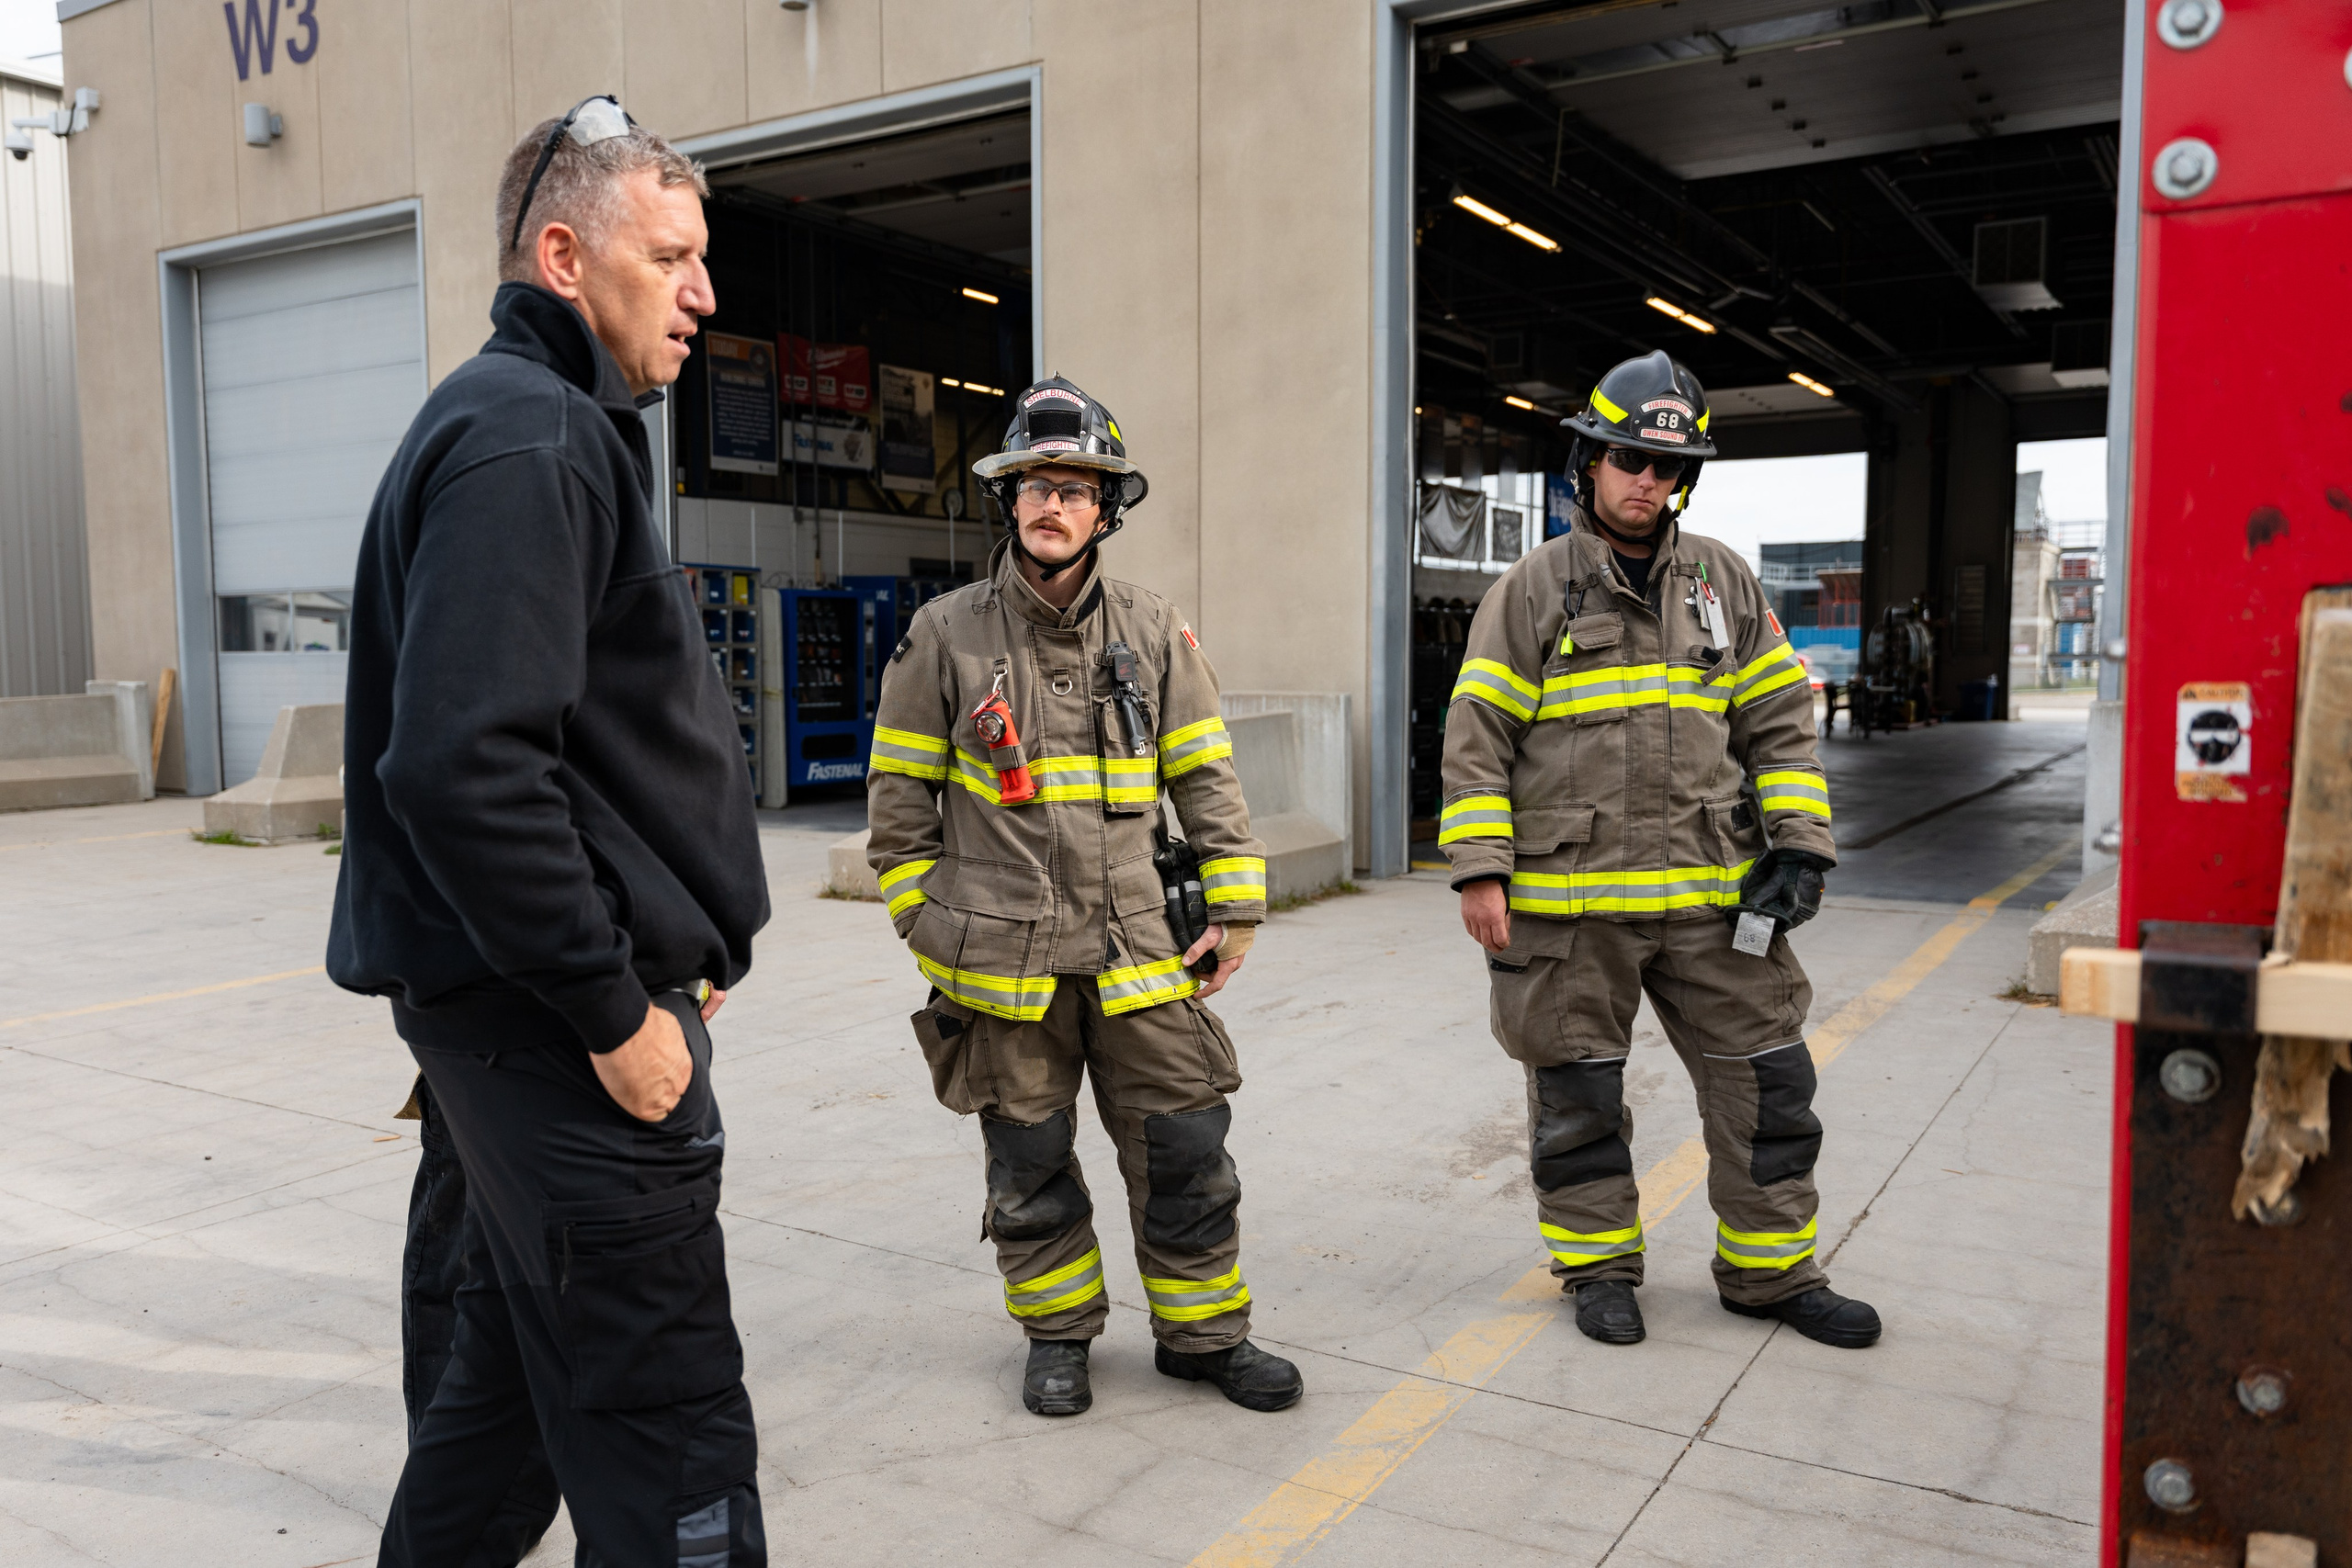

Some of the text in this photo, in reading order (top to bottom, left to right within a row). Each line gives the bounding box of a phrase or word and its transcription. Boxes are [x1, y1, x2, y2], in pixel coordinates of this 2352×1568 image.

[223, 0, 320, 81] W3
[711, 338, 739, 358] TODAY
[1026, 389, 1081, 405] SHELBURNE
[1647, 400, 1689, 414] FIREFIGHTER
[1657, 412, 1679, 429] 68
[1643, 429, 1684, 442] OWEN SOUND FD
[1032, 441, 1076, 451] FIREFIGHTER
[807, 761, 864, 781] FASTENAL
[1743, 932, 1756, 943] 68
